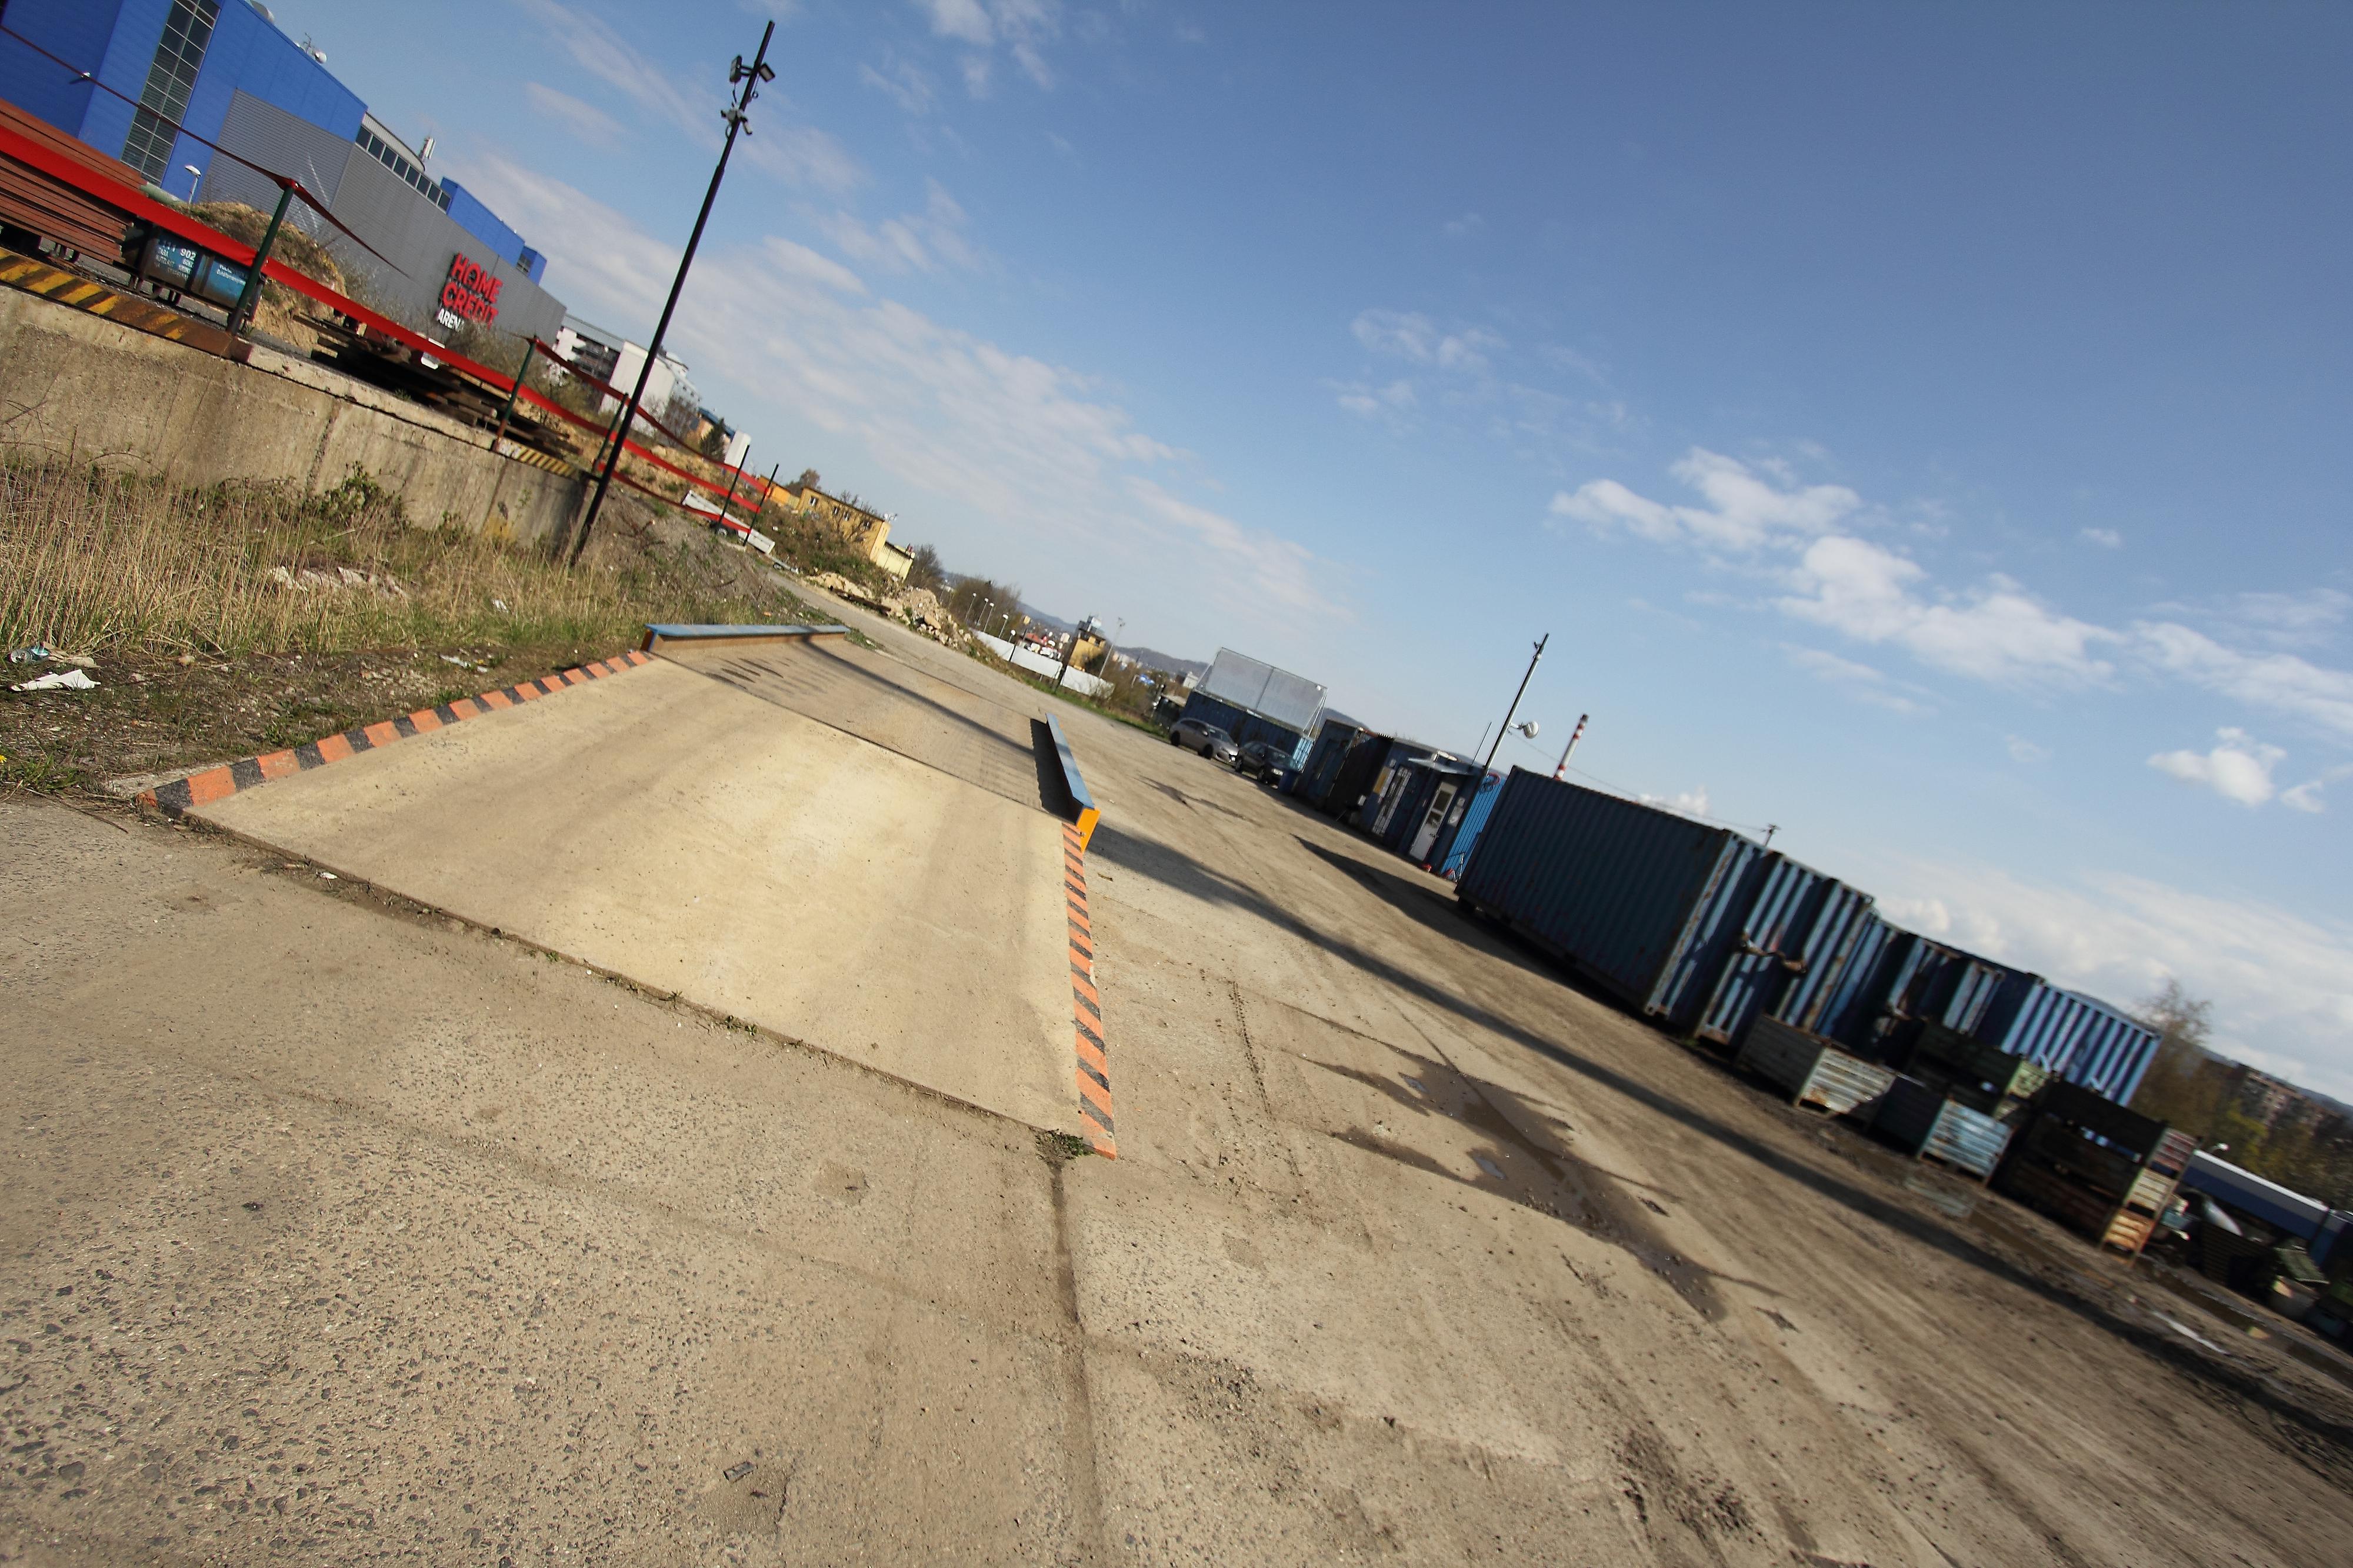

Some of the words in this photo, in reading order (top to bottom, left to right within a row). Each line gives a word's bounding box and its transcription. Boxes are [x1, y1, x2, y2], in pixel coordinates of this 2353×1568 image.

[181, 248, 196, 261] 902
[451, 252, 504, 303] HOME
[442, 282, 499, 330] CREDIT
